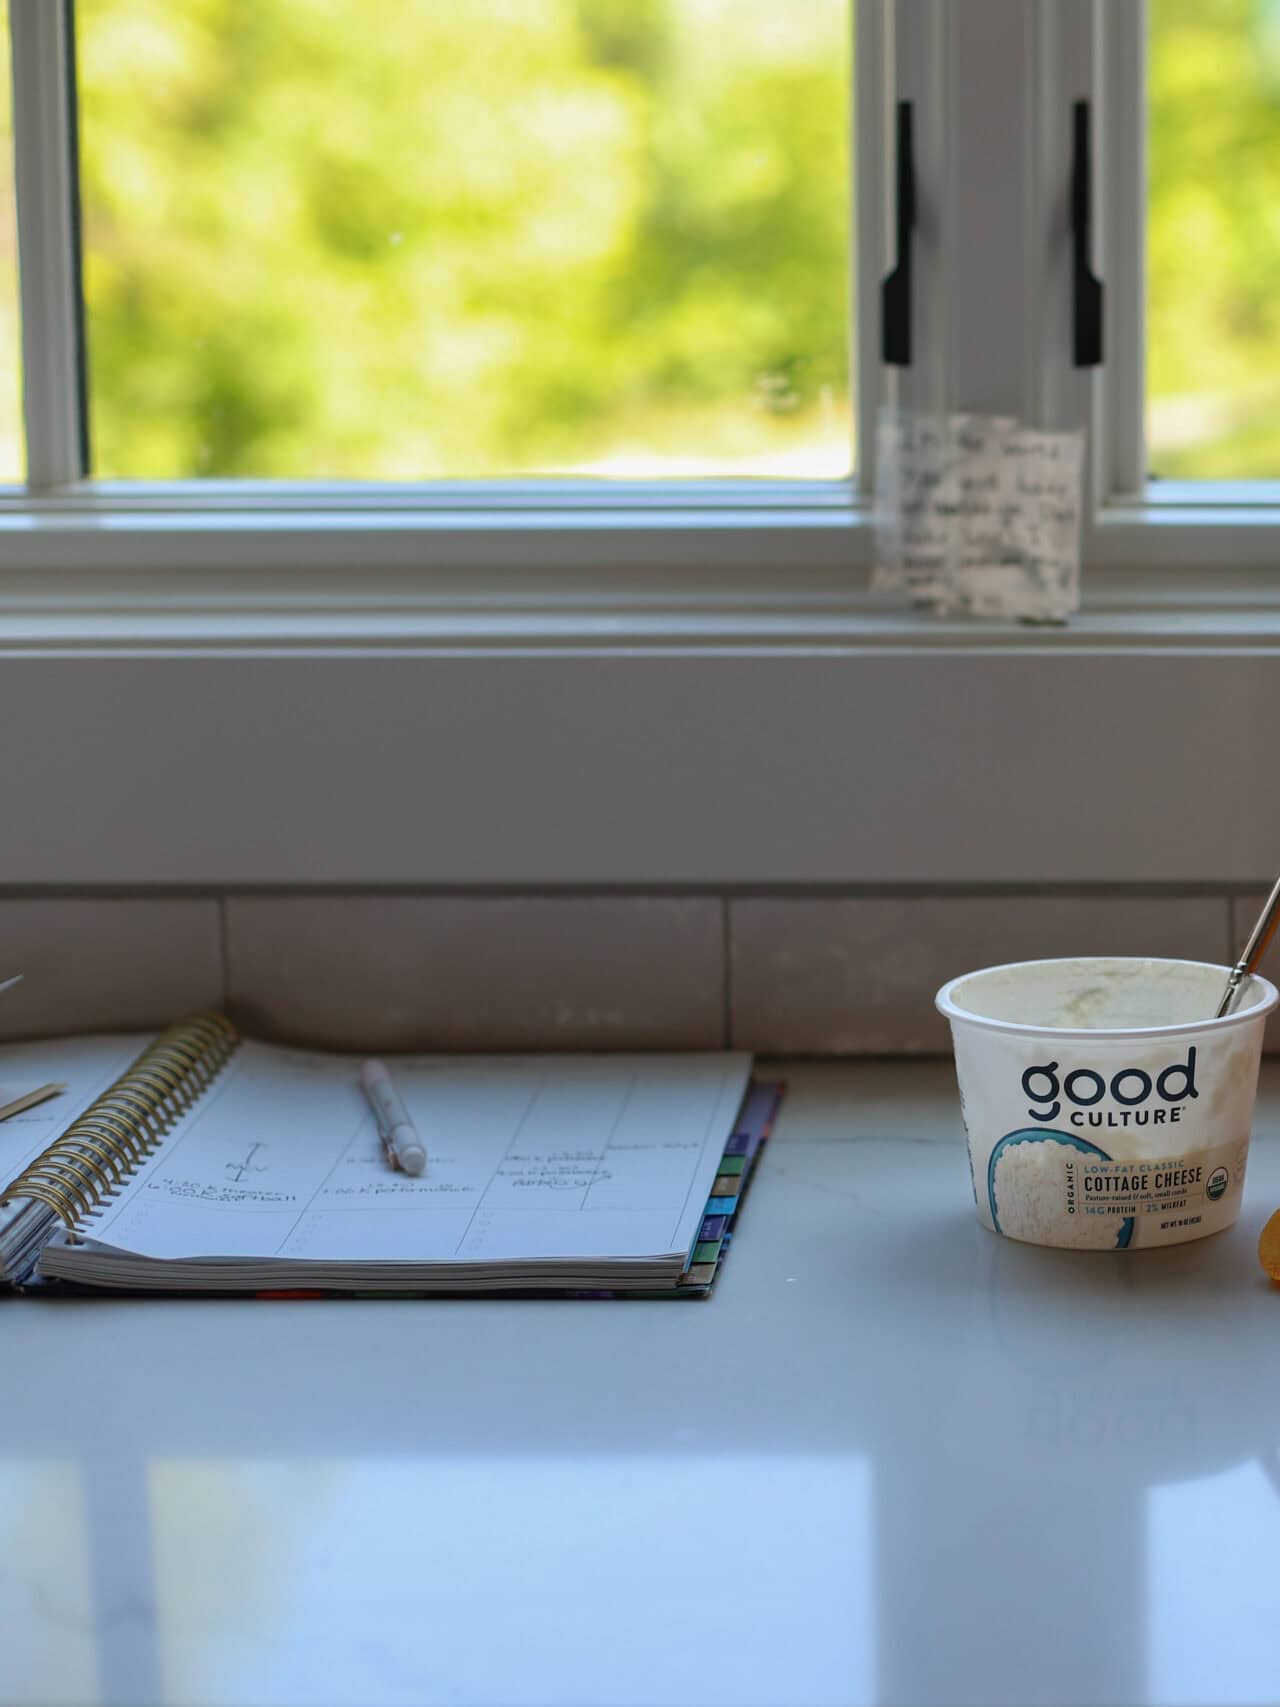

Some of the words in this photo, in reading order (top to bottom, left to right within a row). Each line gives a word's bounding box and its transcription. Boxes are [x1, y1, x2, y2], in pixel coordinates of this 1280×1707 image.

[1021, 1045, 1200, 1121] good
[1084, 1165, 1135, 1174] LOW-FAT
[1139, 1160, 1185, 1172] CLASSIC
[1066, 1162, 1075, 1214] ORGANIC
[1084, 1174, 1149, 1192] COTTAGE
[1154, 1167, 1203, 1188] CHEESE
[1107, 1206, 1136, 1214] PROTEIN
[1161, 1199, 1187, 1210] MILKFAT
